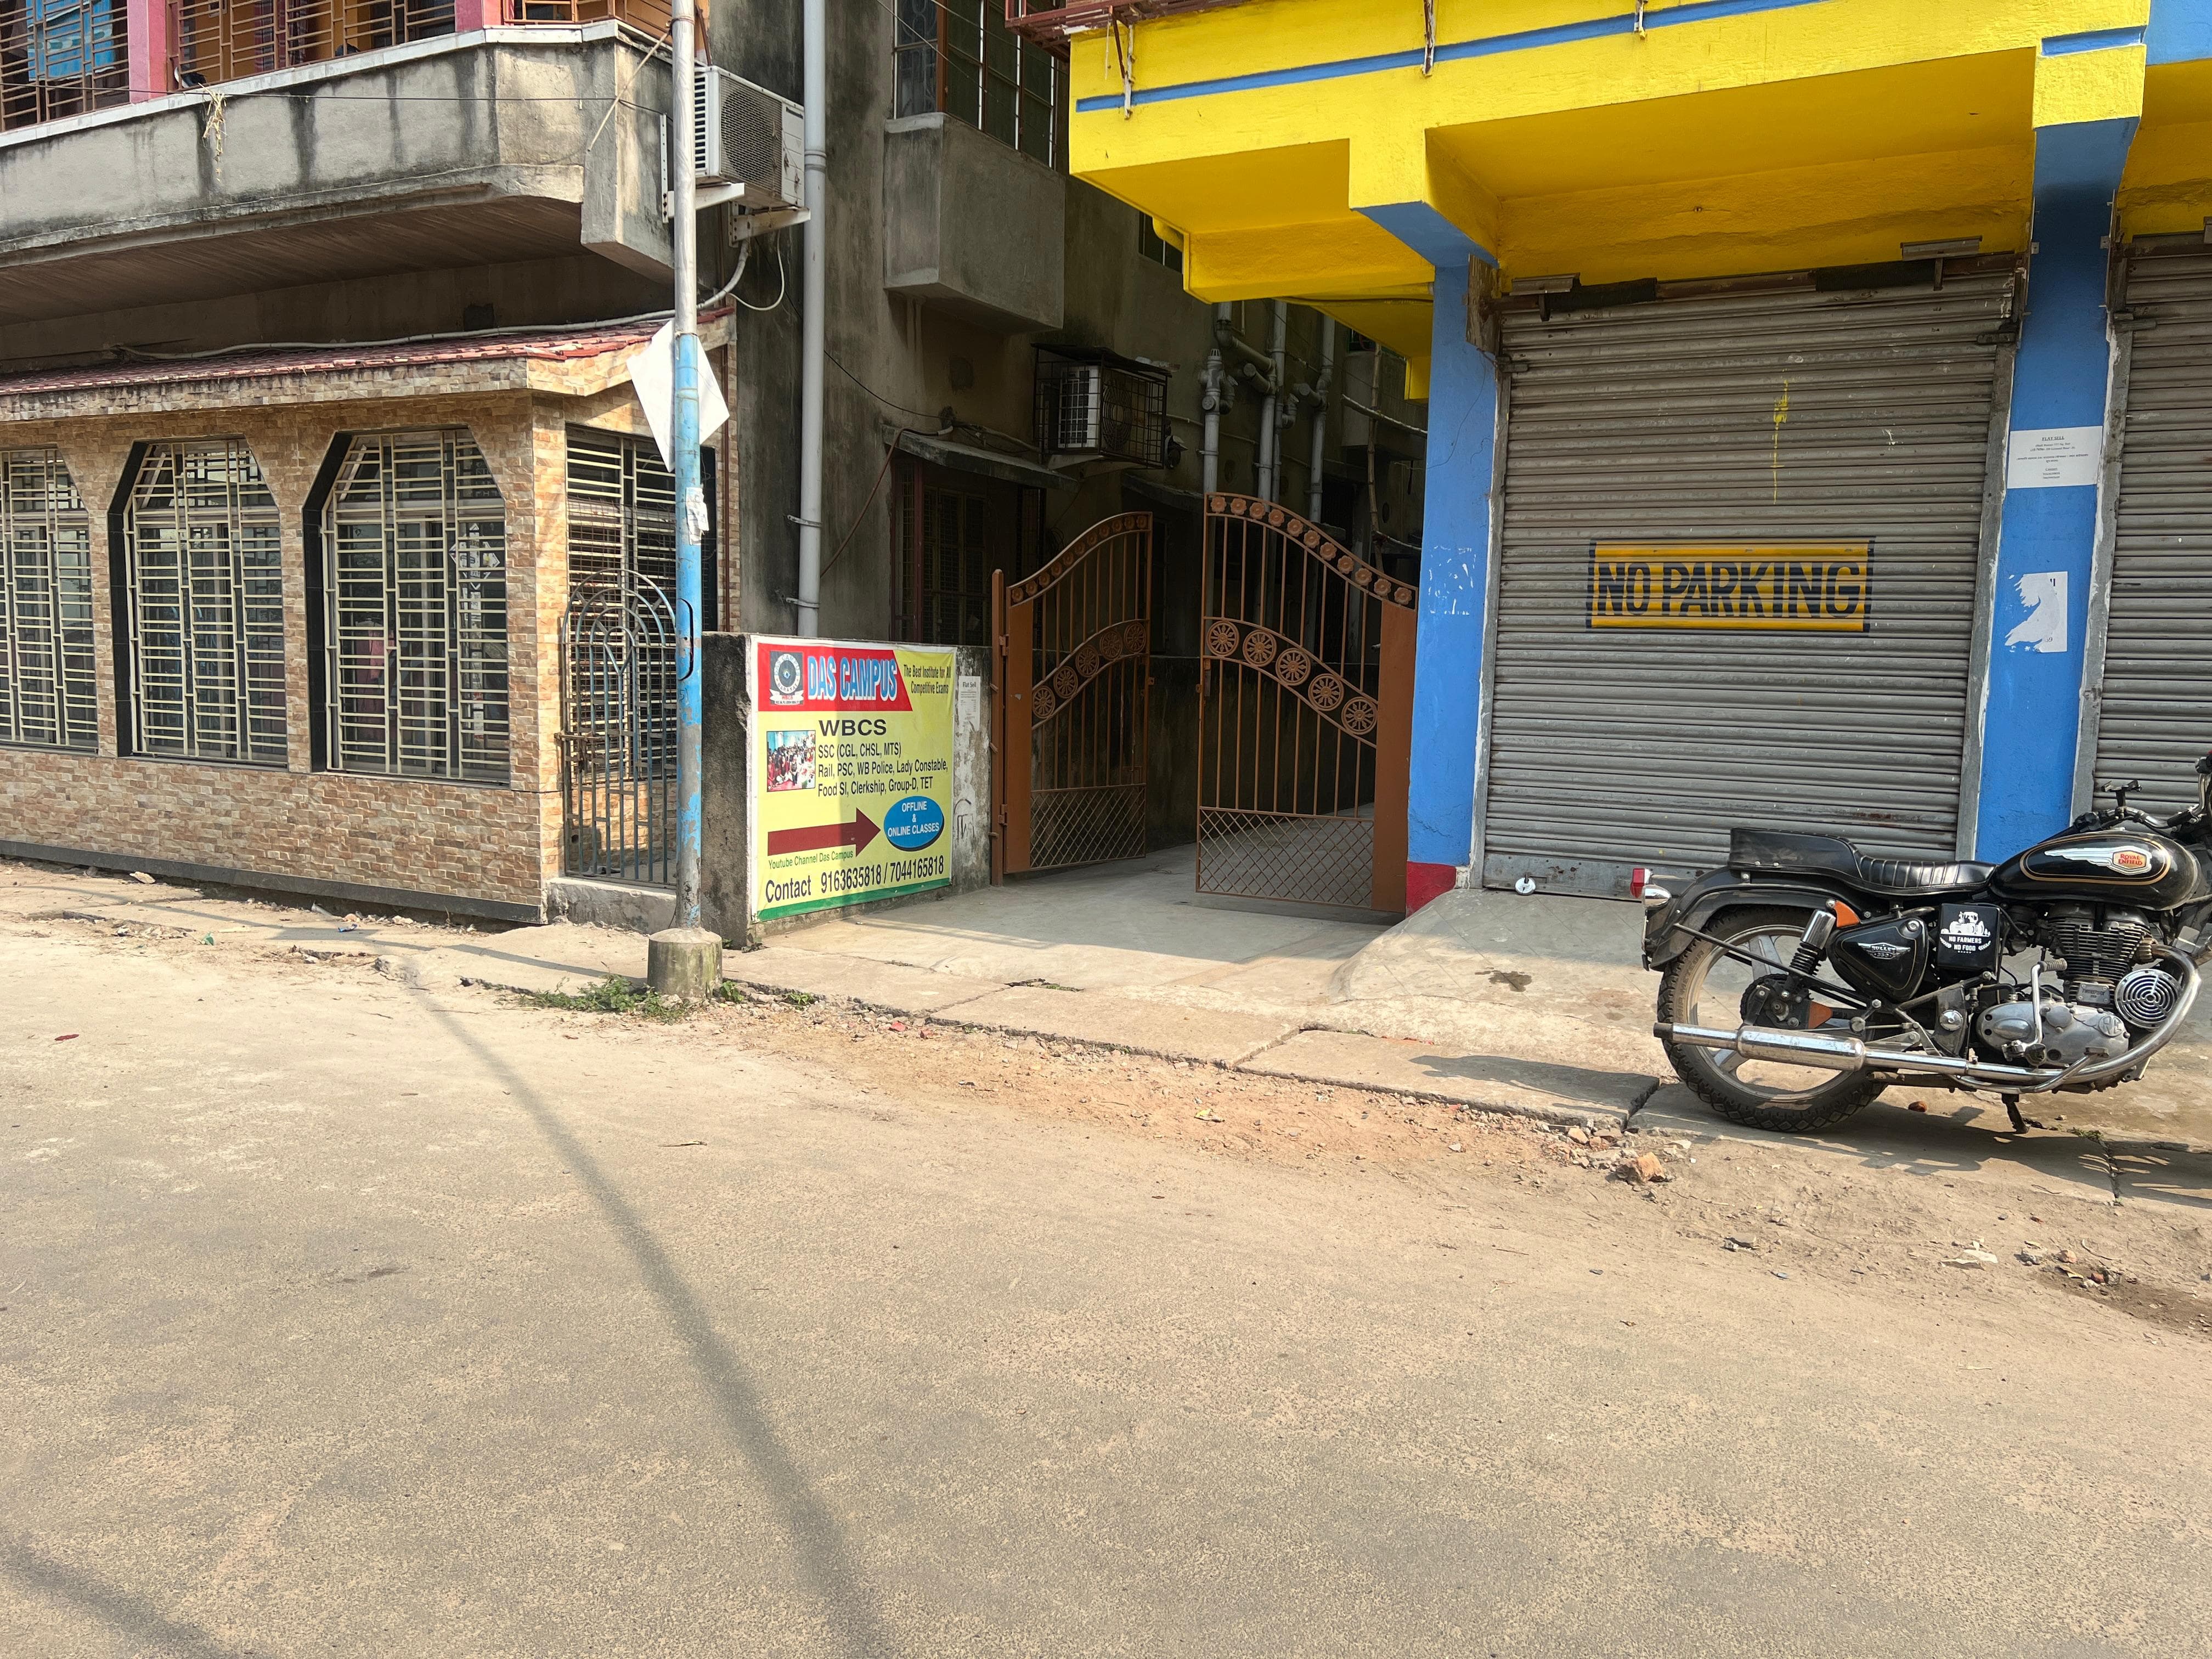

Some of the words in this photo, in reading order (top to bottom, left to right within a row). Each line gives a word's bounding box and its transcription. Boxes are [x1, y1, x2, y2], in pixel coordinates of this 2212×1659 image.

[1598, 562, 1650, 616] NO
[1662, 562, 1861, 618] PARKING
[808, 656, 836, 701] DAS
[840, 657, 898, 702] CAMPUS
[913, 665, 922, 678] Best
[923, 665, 939, 678] Institute
[911, 681, 935, 696] Competitive
[936, 681, 949, 694] Exams
[819, 719, 887, 736] WBCS
[819, 744, 834, 758] SSC
[837, 743, 858, 760] (CGL,
[860, 743, 882, 758] CHSL,
[884, 742, 901, 758] MTS)
[819, 764, 834, 779] Rail,
[838, 763, 855, 778] PSC,
[857, 762, 870, 775] WB
[872, 760, 895, 775] Police,
[897, 760, 913, 775] Lady
[915, 758, 948, 772] Constable,
[818, 782, 837, 797] Food
[839, 781, 849, 797] SI,
[851, 780, 887, 795] Clerkship,
[889, 777, 918, 794] Group-D,
[920, 776, 933, 789] TET
[902, 801, 927, 812] OFFLINE
[912, 814, 917, 822] &
[888, 825, 911, 838] ONLINE
[912, 822, 939, 834] CLASSES
[769, 858, 793, 869] Youtube
[794, 853, 817, 866] Channel
[819, 852, 830, 861] Das
[831, 850, 853, 863] Campus
[766, 874, 811, 903] Contact
[821, 864, 882, 894] 9163635818
[890, 855, 944, 882] 7044165818
[2103, 1015, 2121, 1034] RE
